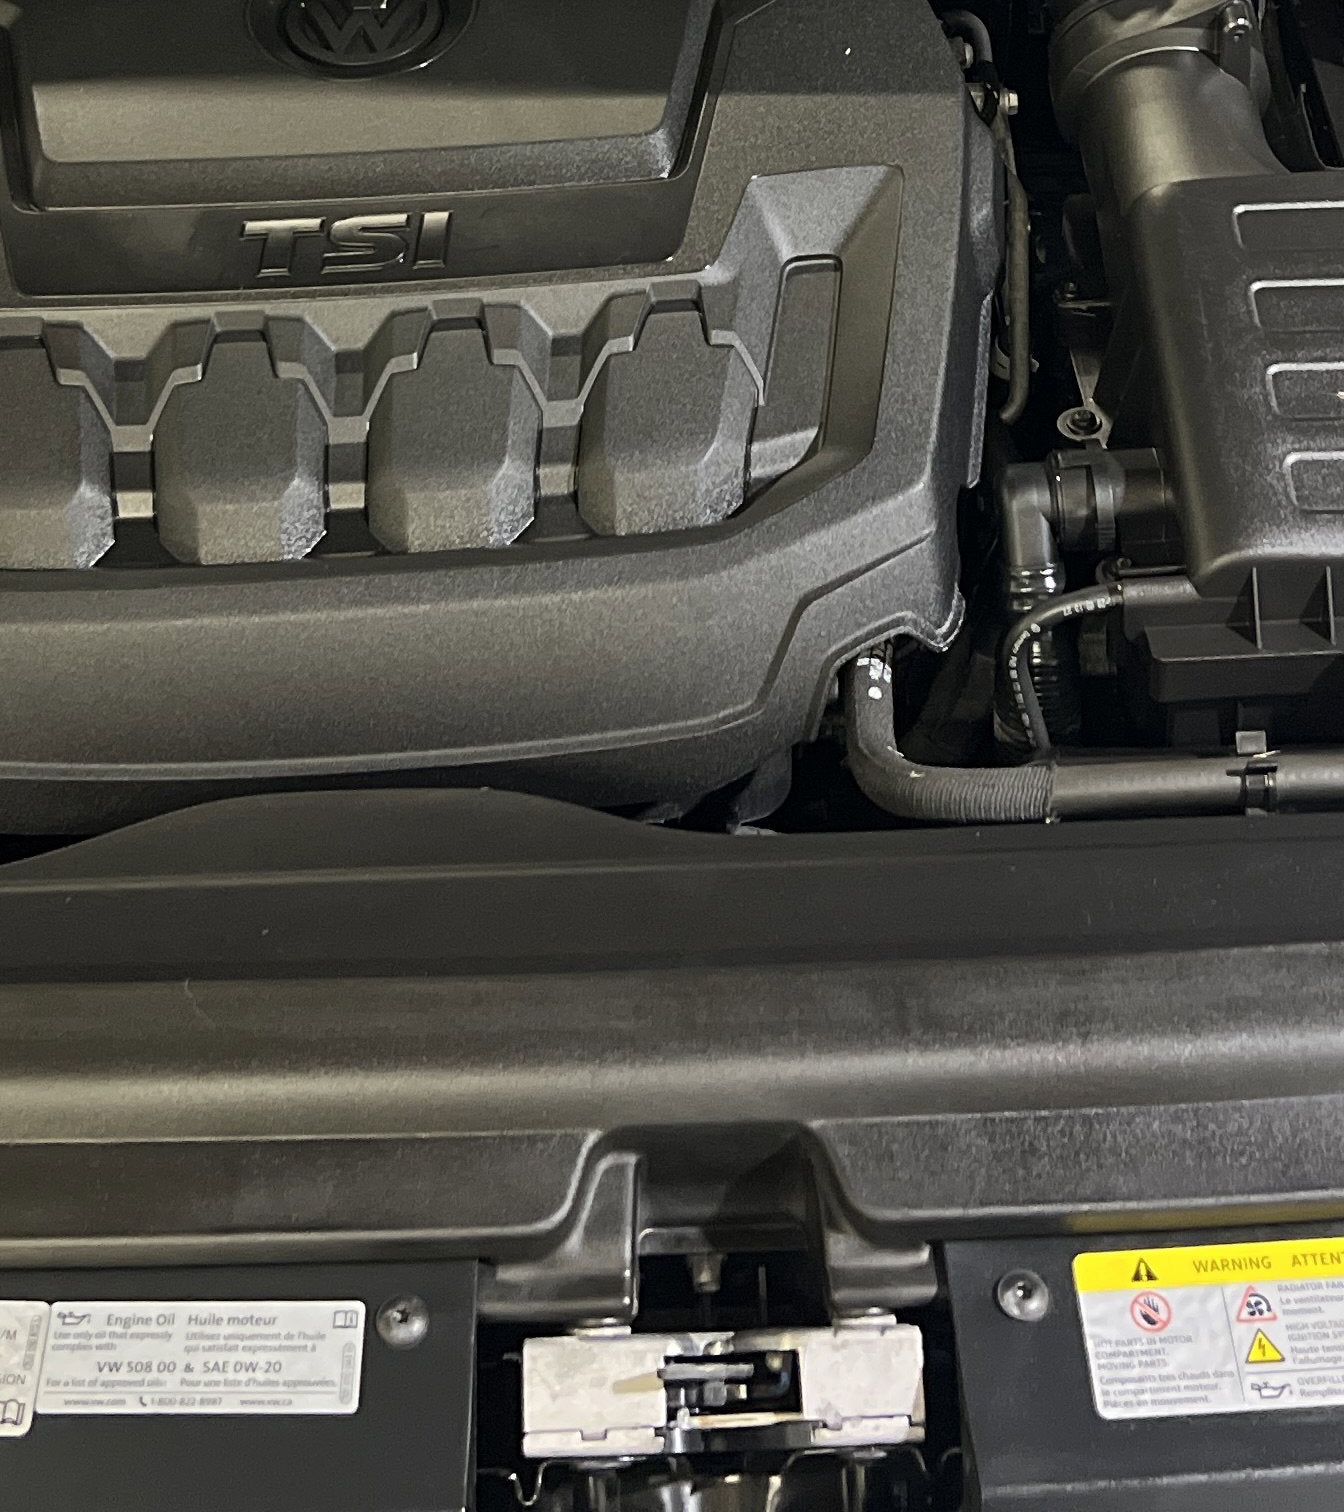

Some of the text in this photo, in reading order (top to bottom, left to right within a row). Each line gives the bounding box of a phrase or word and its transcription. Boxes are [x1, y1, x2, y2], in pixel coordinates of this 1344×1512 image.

[240, 210, 454, 278] TSI
[1192, 1255, 1273, 1274] WARNING
[106, 1312, 176, 1329] Engine Oil
[187, 1313, 278, 1326] Huile moteur
[283, 1331, 297, 1341] de
[97, 1360, 283, 1374] VW 508 00 & SAE 0W-20
[46, 1377, 62, 1387] For
[71, 1376, 86, 1387] list
[87, 1377, 99, 1387] of
[179, 1377, 202, 1388] Pour
